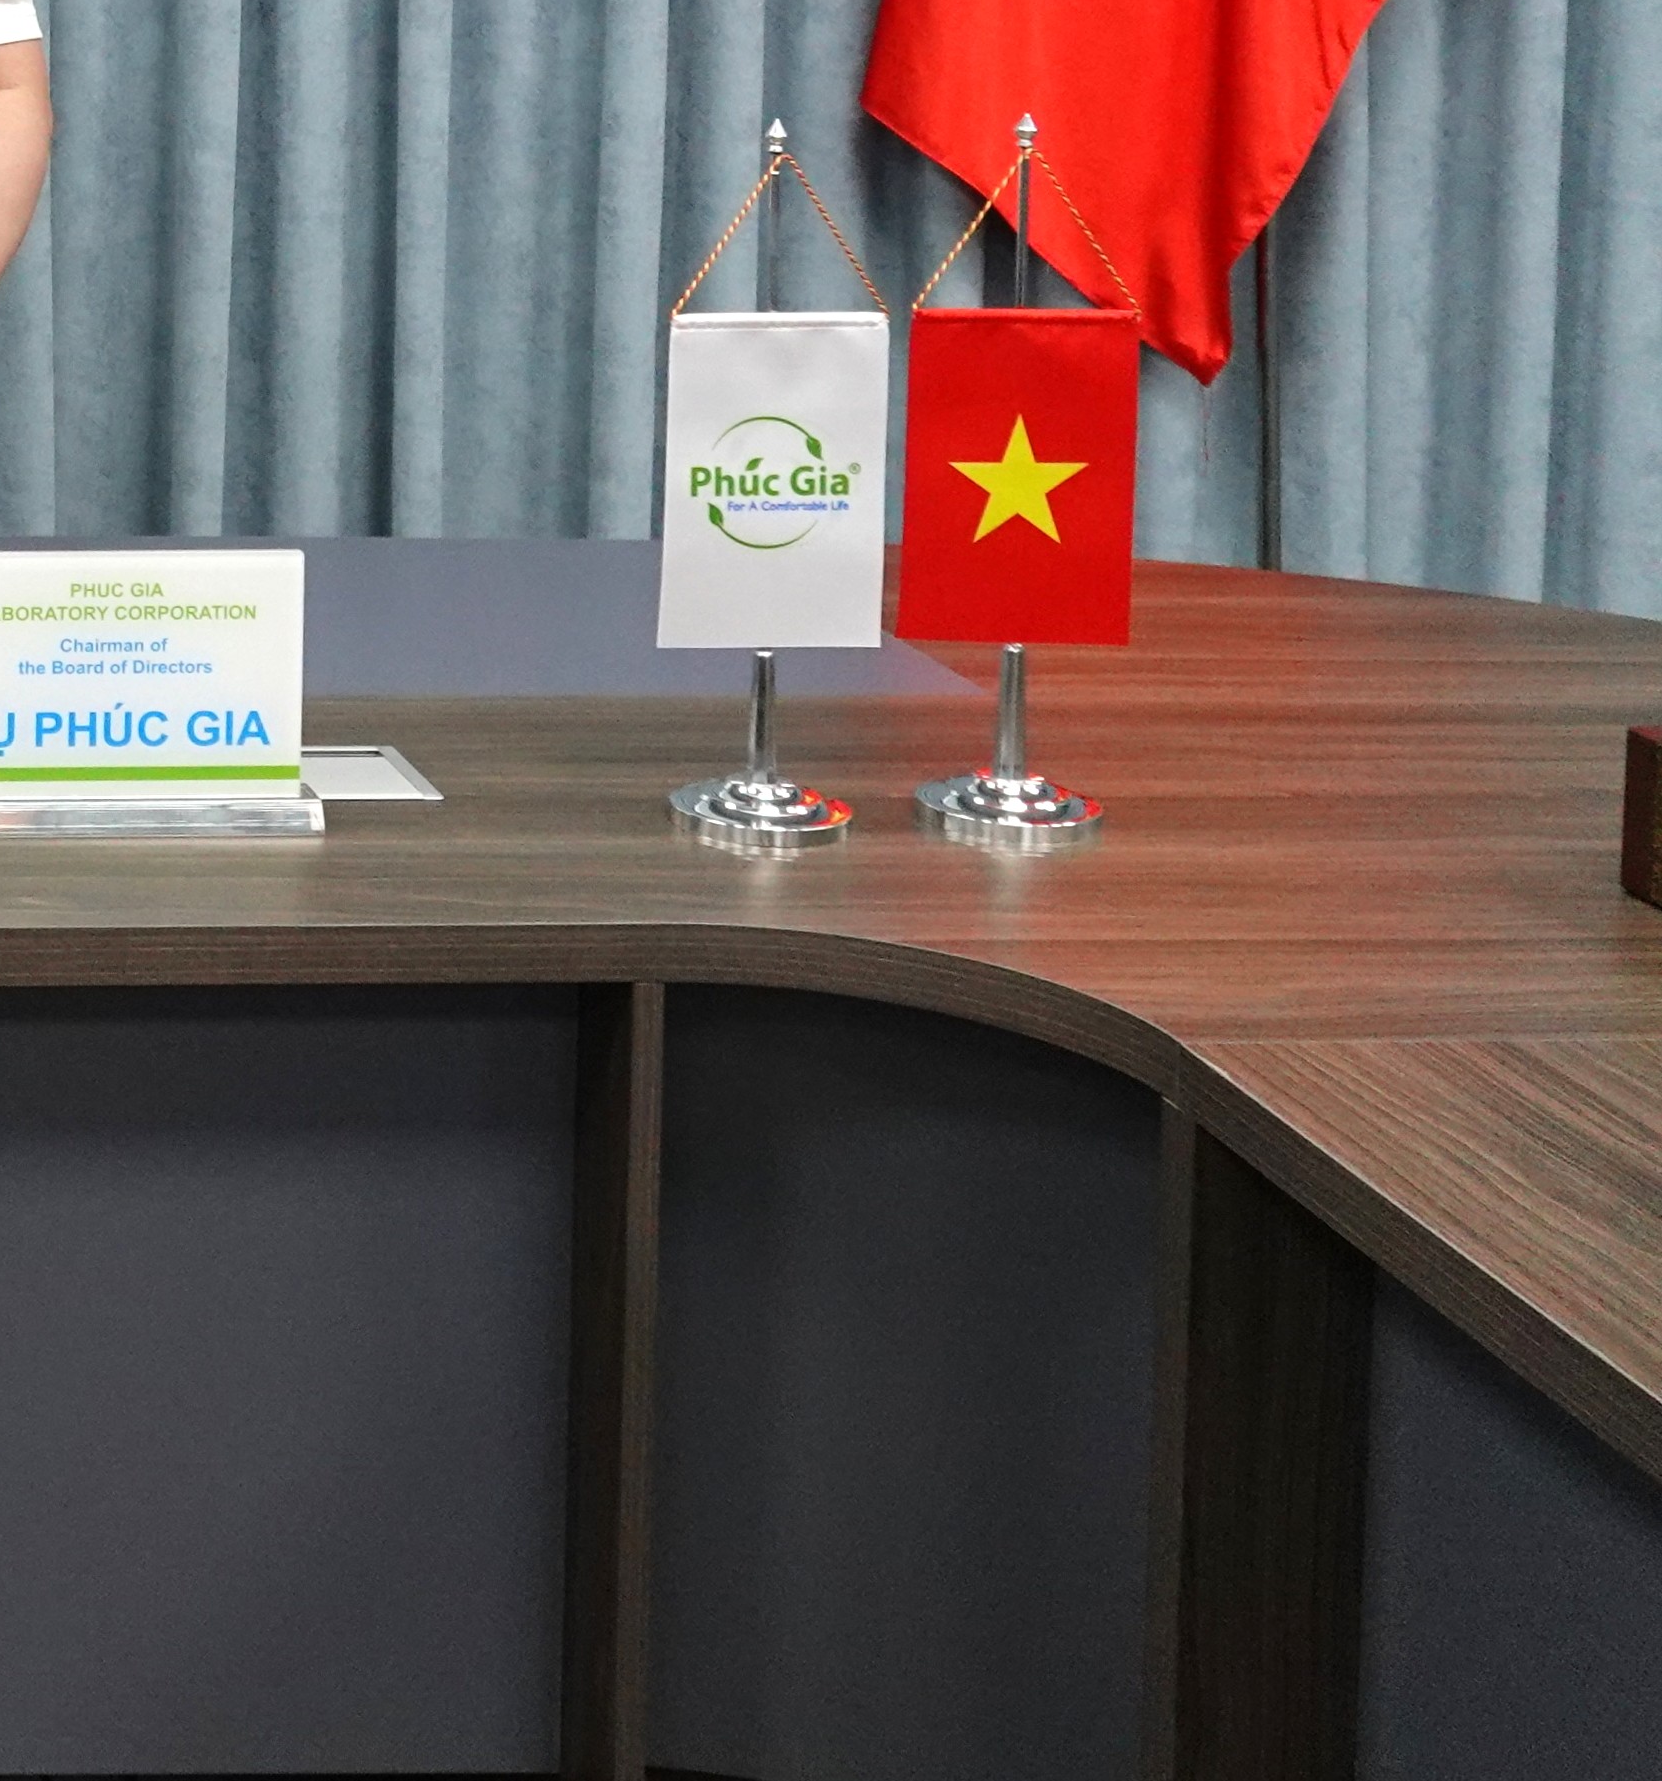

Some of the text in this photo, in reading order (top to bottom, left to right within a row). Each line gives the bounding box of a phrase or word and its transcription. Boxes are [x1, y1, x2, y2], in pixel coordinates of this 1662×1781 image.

[690, 457, 781, 497] Phúc
[790, 465, 850, 496] Gia
[728, 500, 849, 511] For A Comfortable Life
[70, 583, 164, 598] PHUC GIA
[114, 605, 257, 620] CORPORATION
[60, 638, 169, 652] Chairman of
[18, 660, 213, 675] the Board of Directors
[34, 702, 168, 748] PHÚC
[186, 709, 270, 746] GIA
